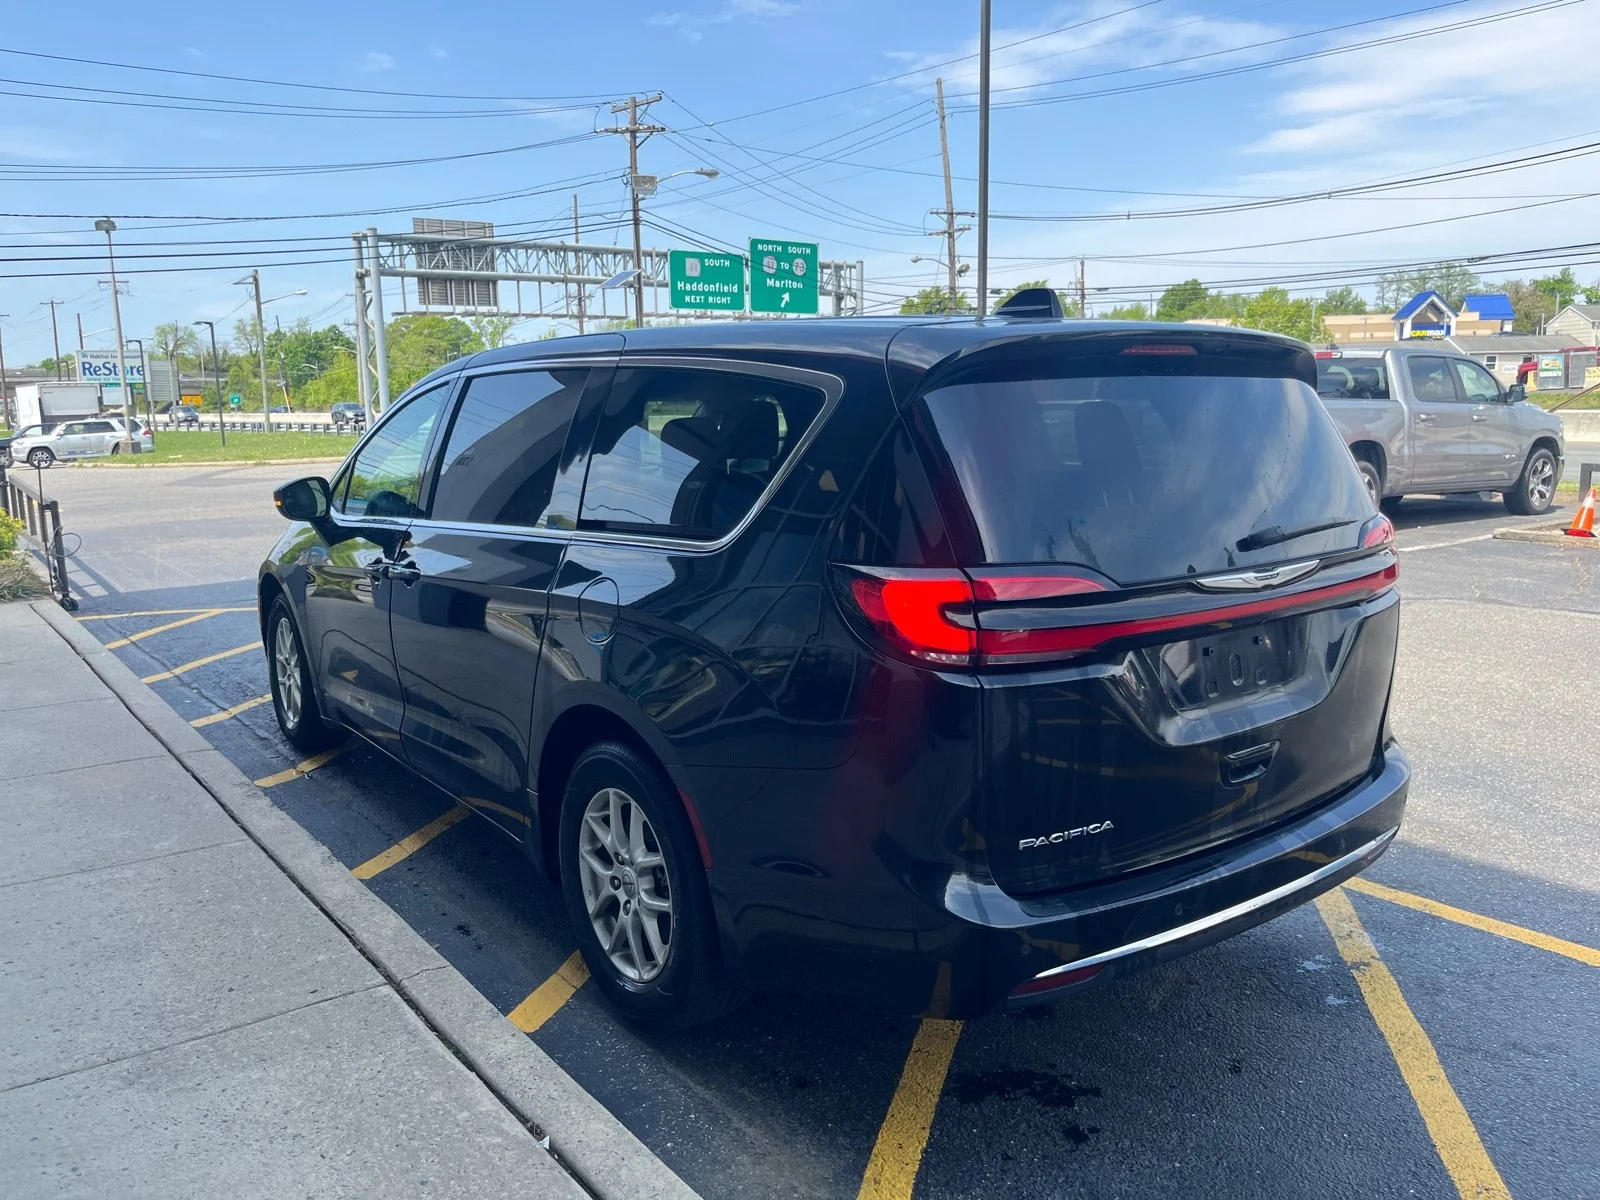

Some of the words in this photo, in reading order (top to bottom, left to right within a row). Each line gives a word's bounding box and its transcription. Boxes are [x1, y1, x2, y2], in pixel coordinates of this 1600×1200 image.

[757, 243, 782, 253] NORTH
[787, 246, 811, 255] SOUTH
[704, 258, 730, 268] SOUTH
[780, 262, 790, 270] TO
[677, 280, 738, 293] Haddonfield
[766, 277, 803, 289] Marlton
[684, 295, 705, 304] NEXT
[708, 296, 731, 305] RIGHT
[1018, 820, 1114, 851] PACIFICA
